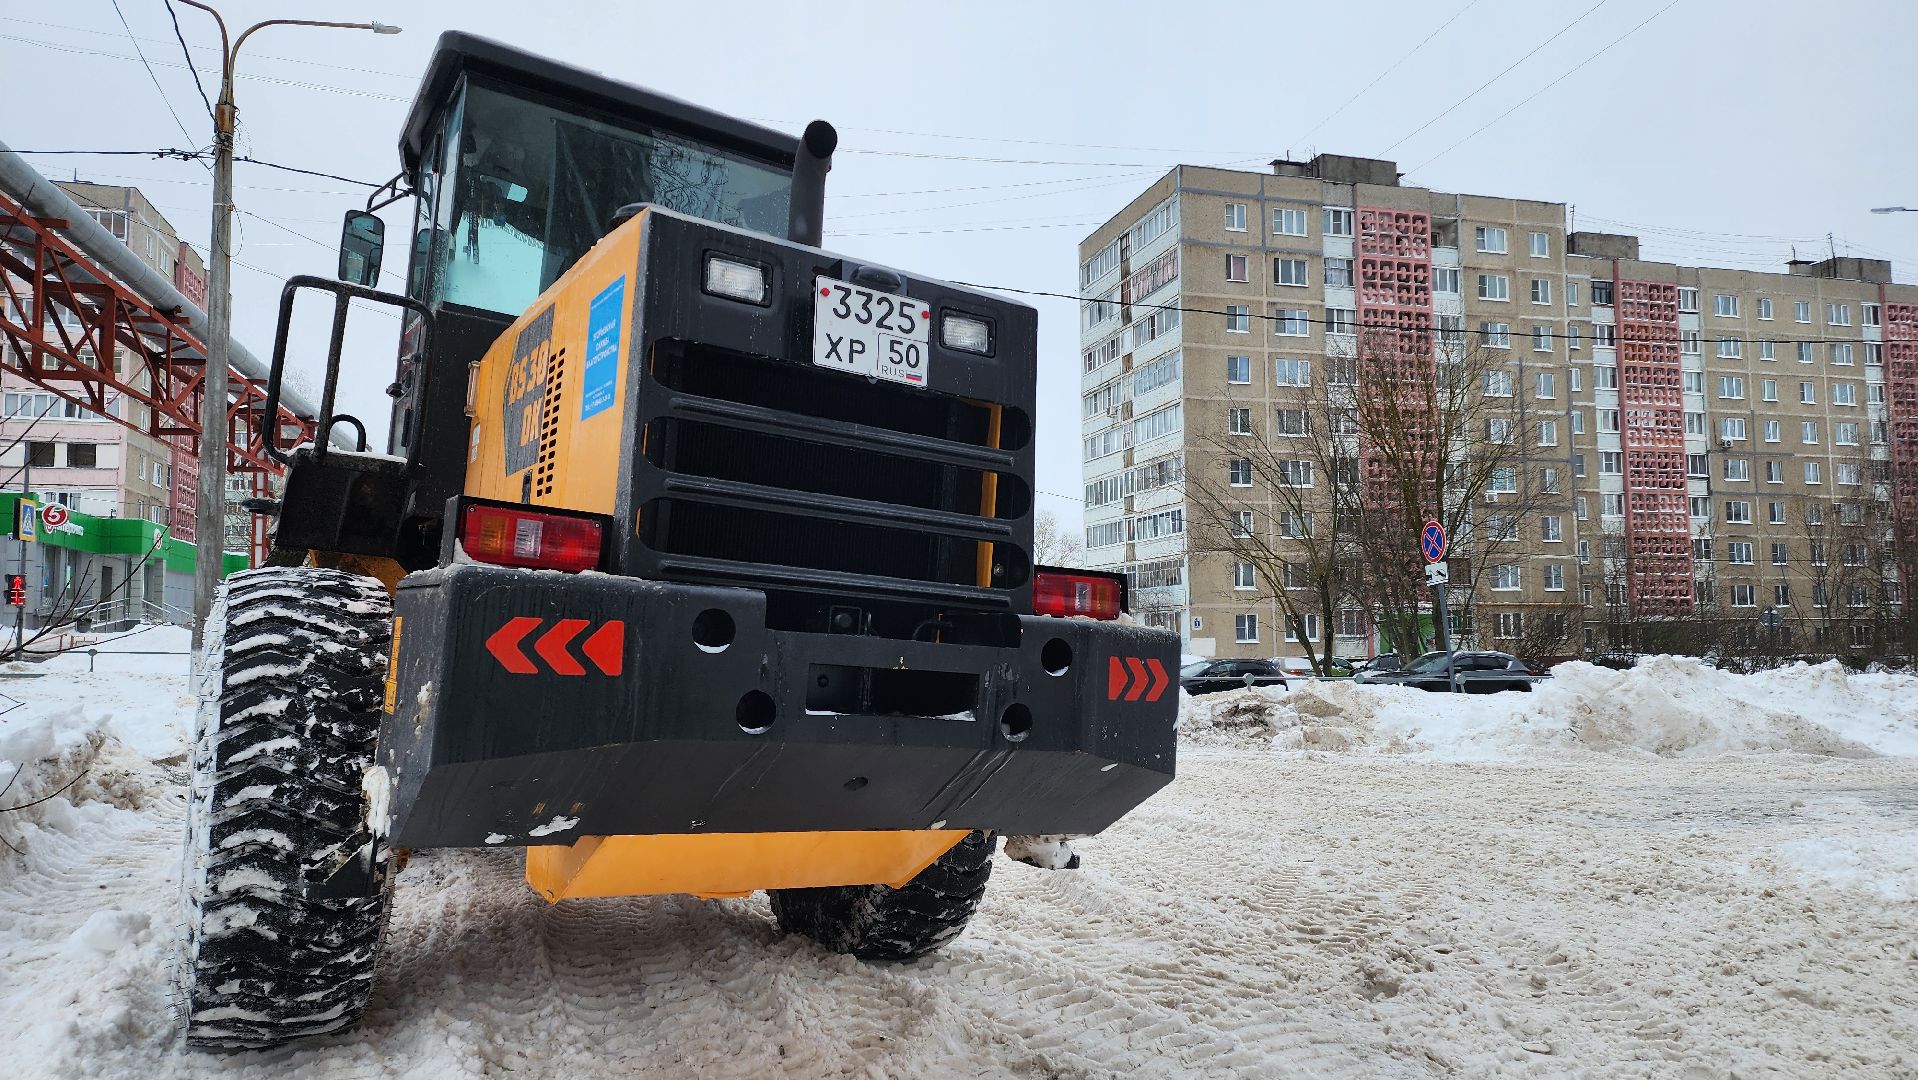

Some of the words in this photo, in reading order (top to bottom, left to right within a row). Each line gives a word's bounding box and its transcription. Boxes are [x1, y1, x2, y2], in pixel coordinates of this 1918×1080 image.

[832, 284, 916, 334] 3325
[888, 340, 920, 368] 50
[881, 365, 905, 378] RUS
[47, 505, 64, 522] 5
